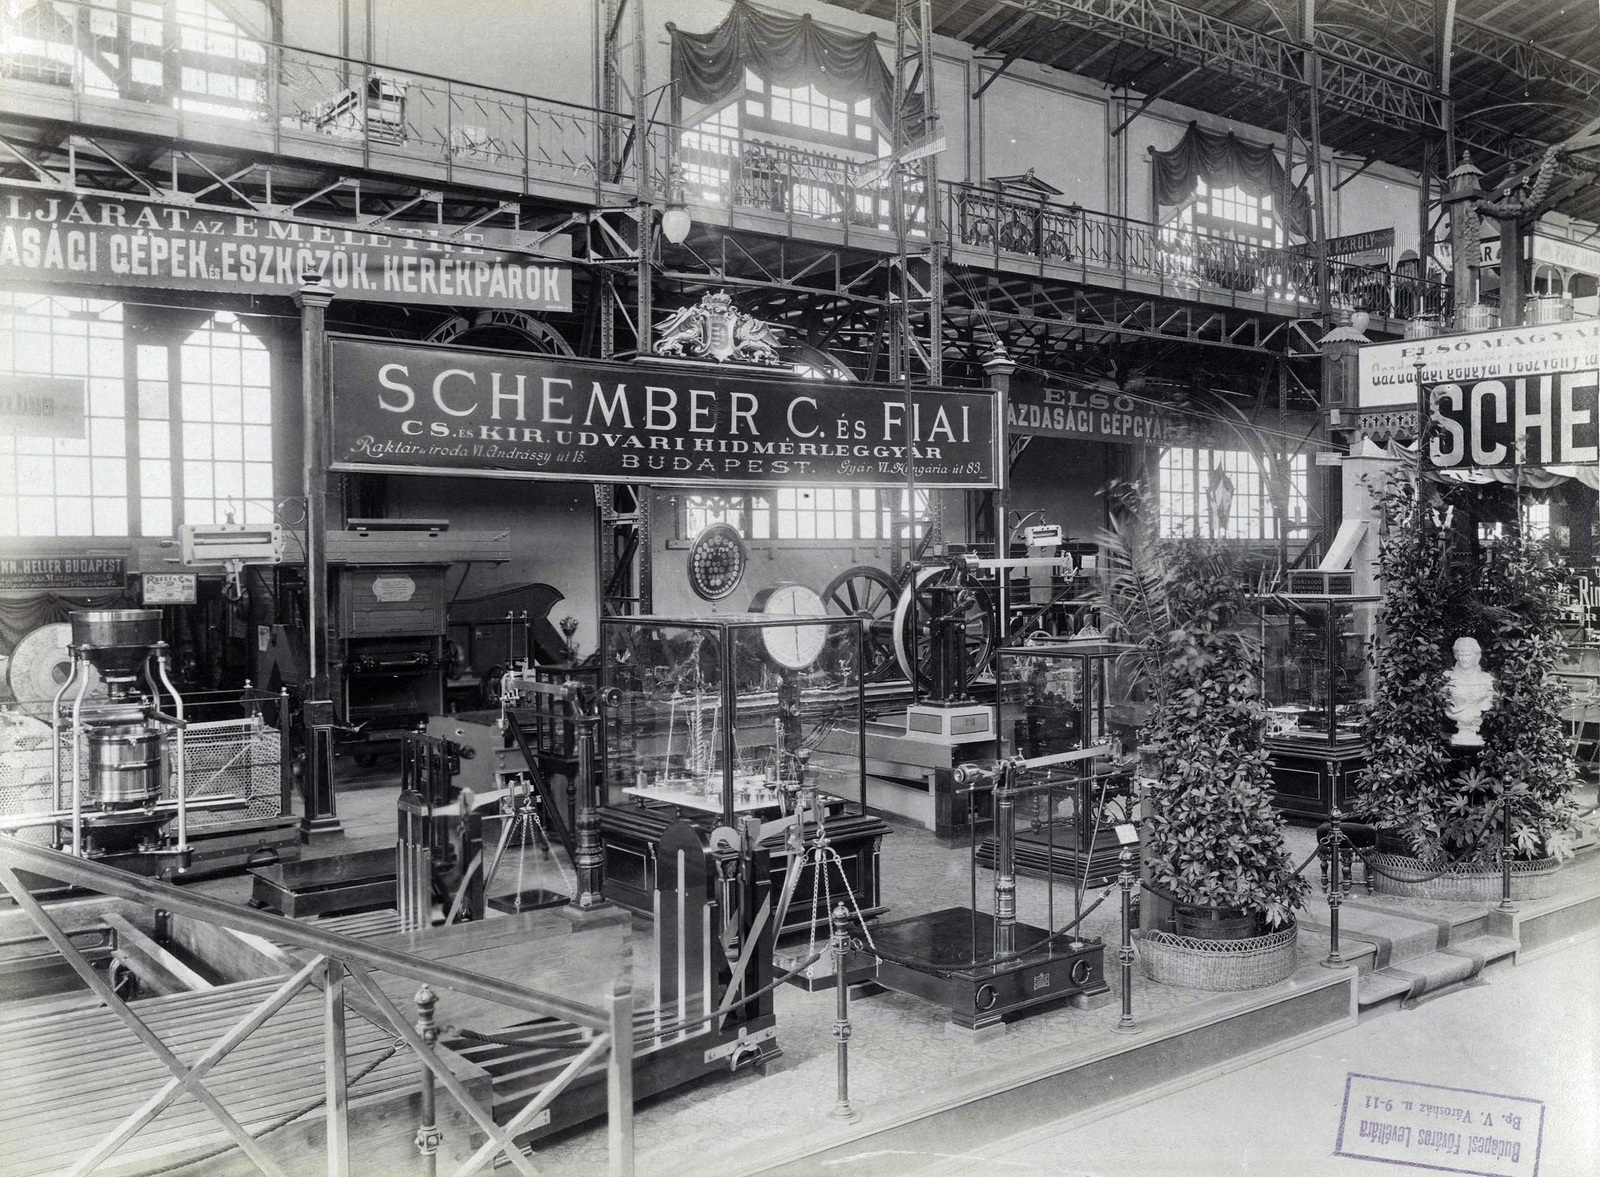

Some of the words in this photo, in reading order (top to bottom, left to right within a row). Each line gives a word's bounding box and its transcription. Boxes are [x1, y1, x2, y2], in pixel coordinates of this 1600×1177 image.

[191, 220, 226, 235] AZ
[1335, 233, 1375, 254] KÁROLY
[111, 229, 212, 279] GÉPEK
[209, 263, 220, 281] ÉS
[384, 254, 562, 302] KERÉKPÁROK
[377, 363, 760, 437] SCHEMBER
[787, 397, 825, 438] C.
[836, 413, 867, 440] ÉS
[884, 401, 970, 443] FIAI
[1430, 372, 1599, 467] SCHE
[350, 435, 420, 458] Raktár
[428, 444, 468, 457] iroda
[473, 444, 486, 458] VI.
[486, 445, 552, 466] Andrássy
[556, 450, 569, 463] út
[572, 450, 587, 463] 15.
[401, 420, 457, 439] CS.
[459, 427, 473, 439] ÉS
[479, 425, 551, 444] KIR.
[555, 431, 684, 451] UDVARI
[693, 437, 942, 460] HIDMÉRLEGGYÁR
[622, 454, 816, 475] BUDAPEST.
[837, 459, 873, 476] Gyár
[878, 462, 890, 473] VI.
[967, 462, 983, 474] 83.
[23, 560, 61, 574] HELLER
[65, 559, 121, 573] BUDAPEST
